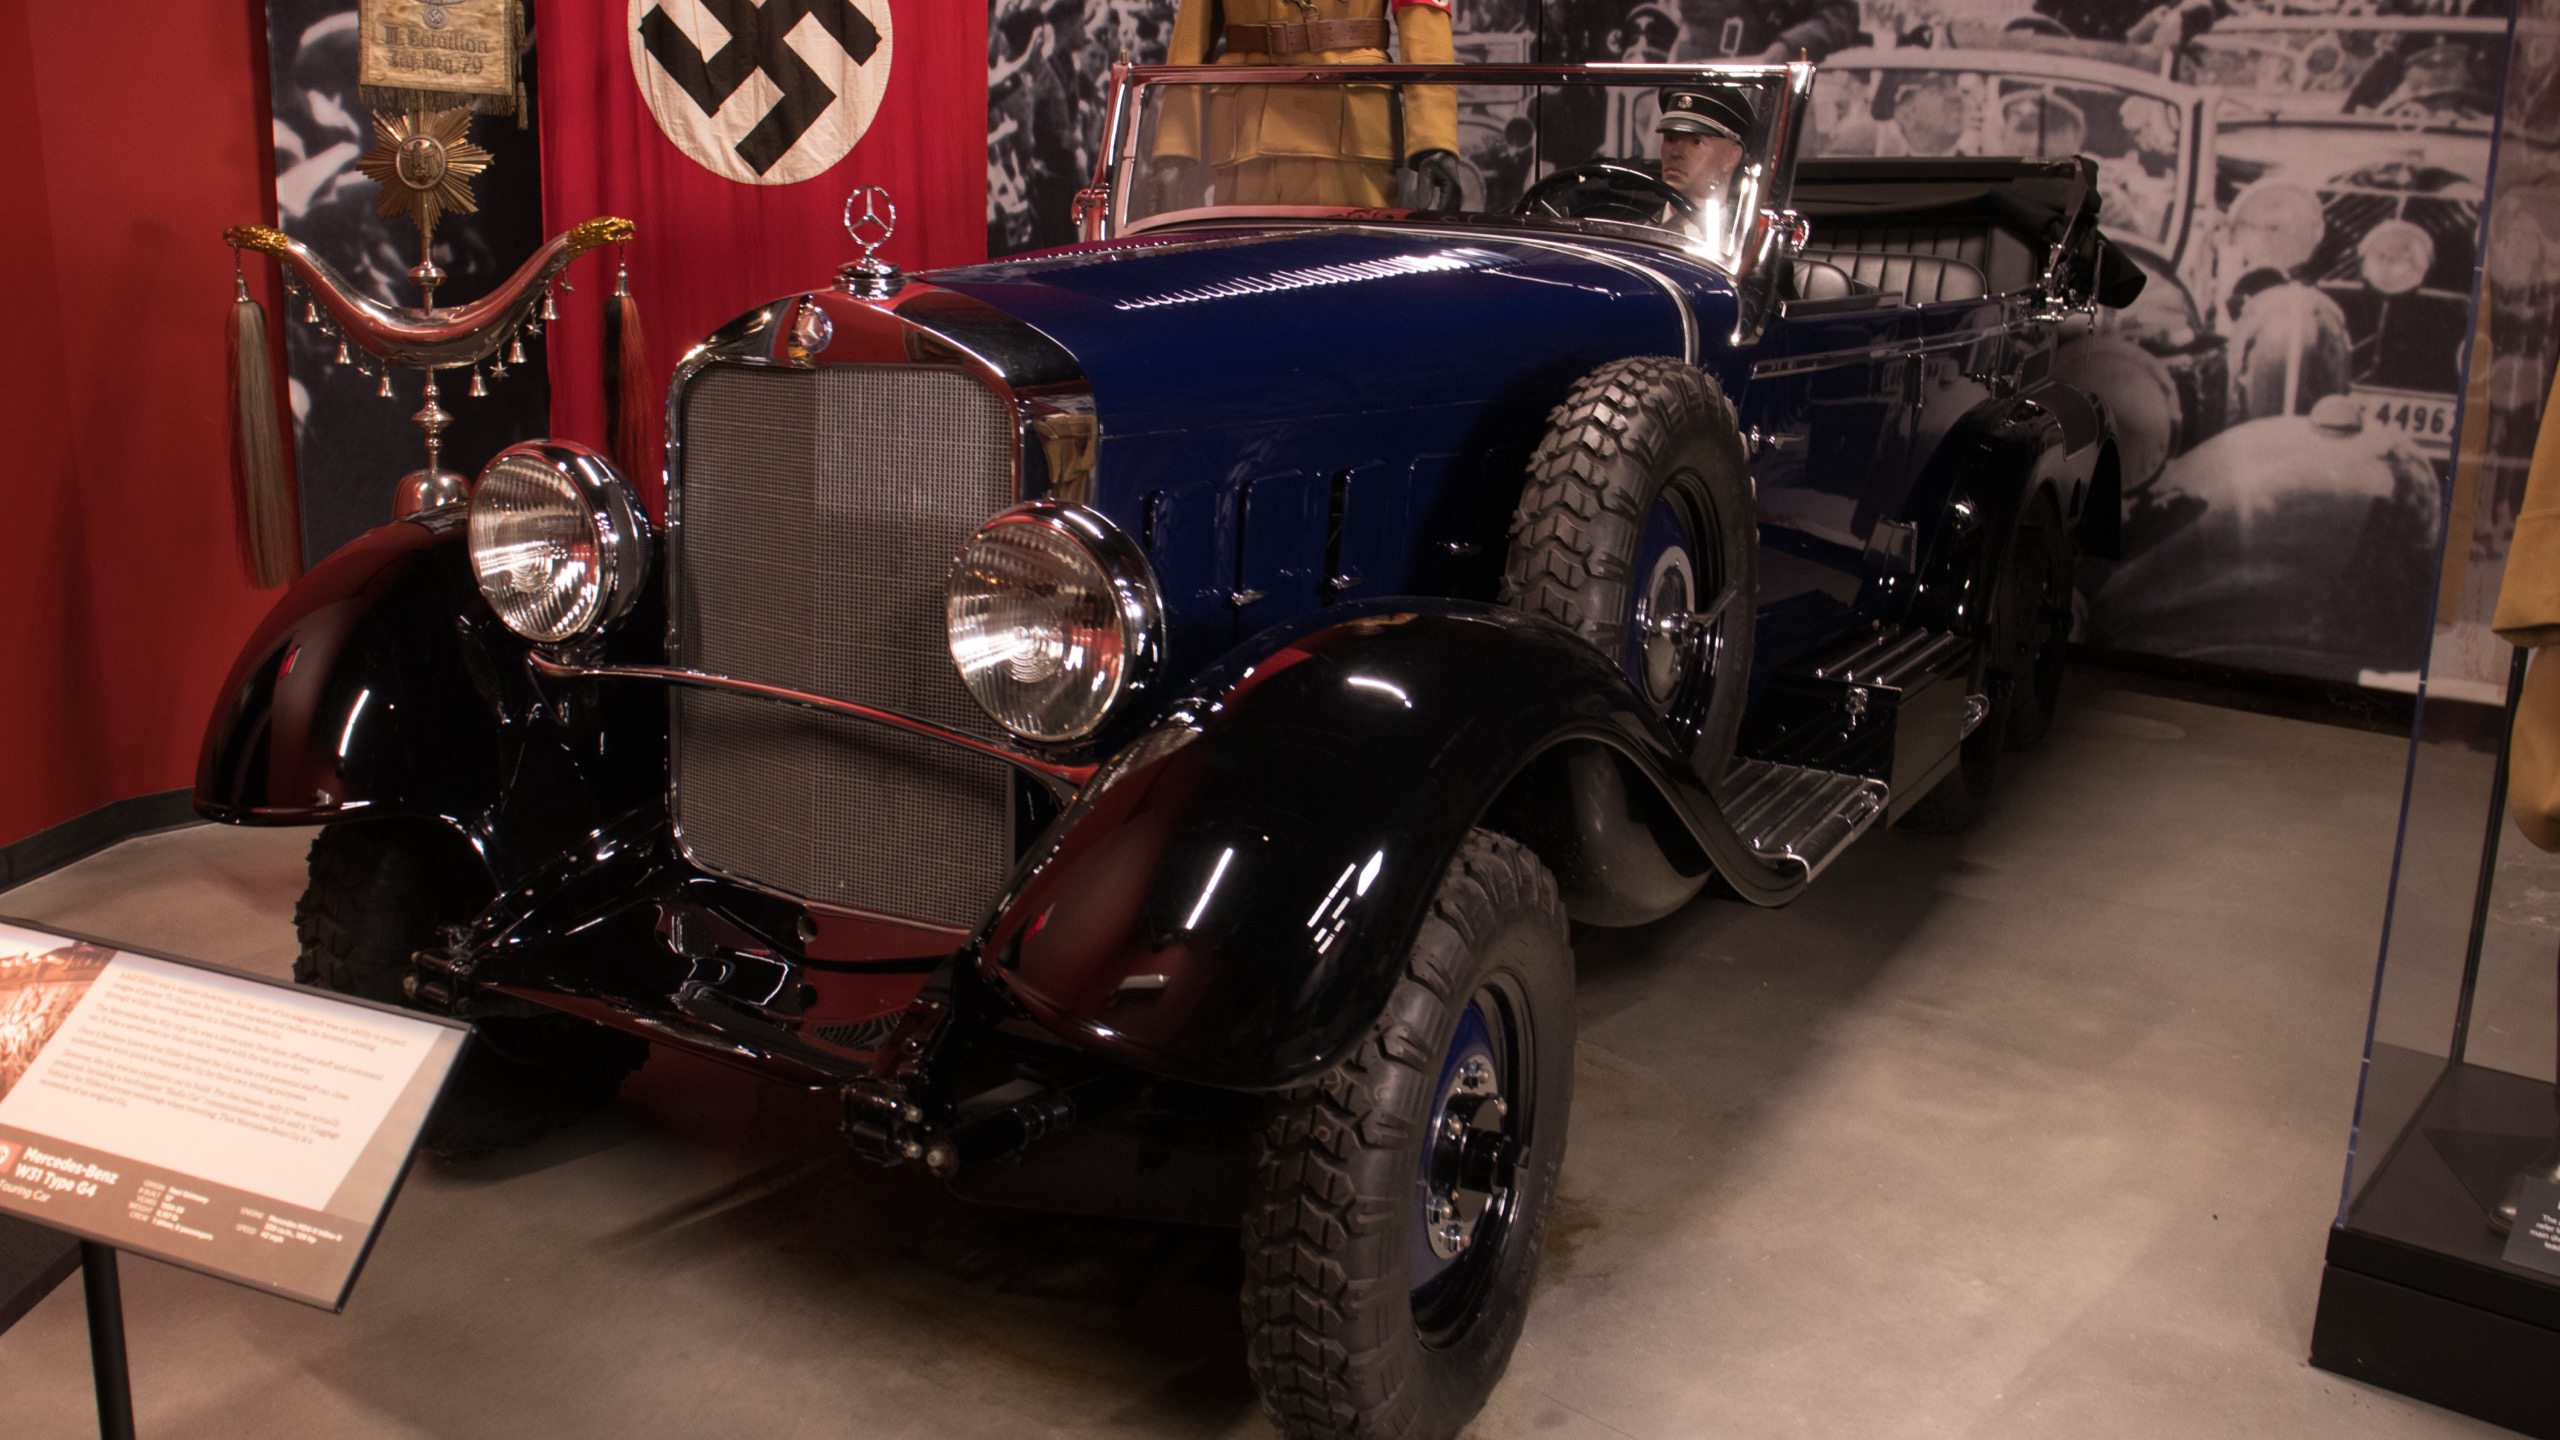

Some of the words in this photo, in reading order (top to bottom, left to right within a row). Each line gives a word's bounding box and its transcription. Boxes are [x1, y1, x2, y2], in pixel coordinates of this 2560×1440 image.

[15, 1163, 44, 1183] W31
[43, 1170, 76, 1191] Type
[76, 1180, 98, 1198] G4
[23, 1146, 119, 1185] Mercedes-Benz
[33, 1189, 50, 1202] Car
